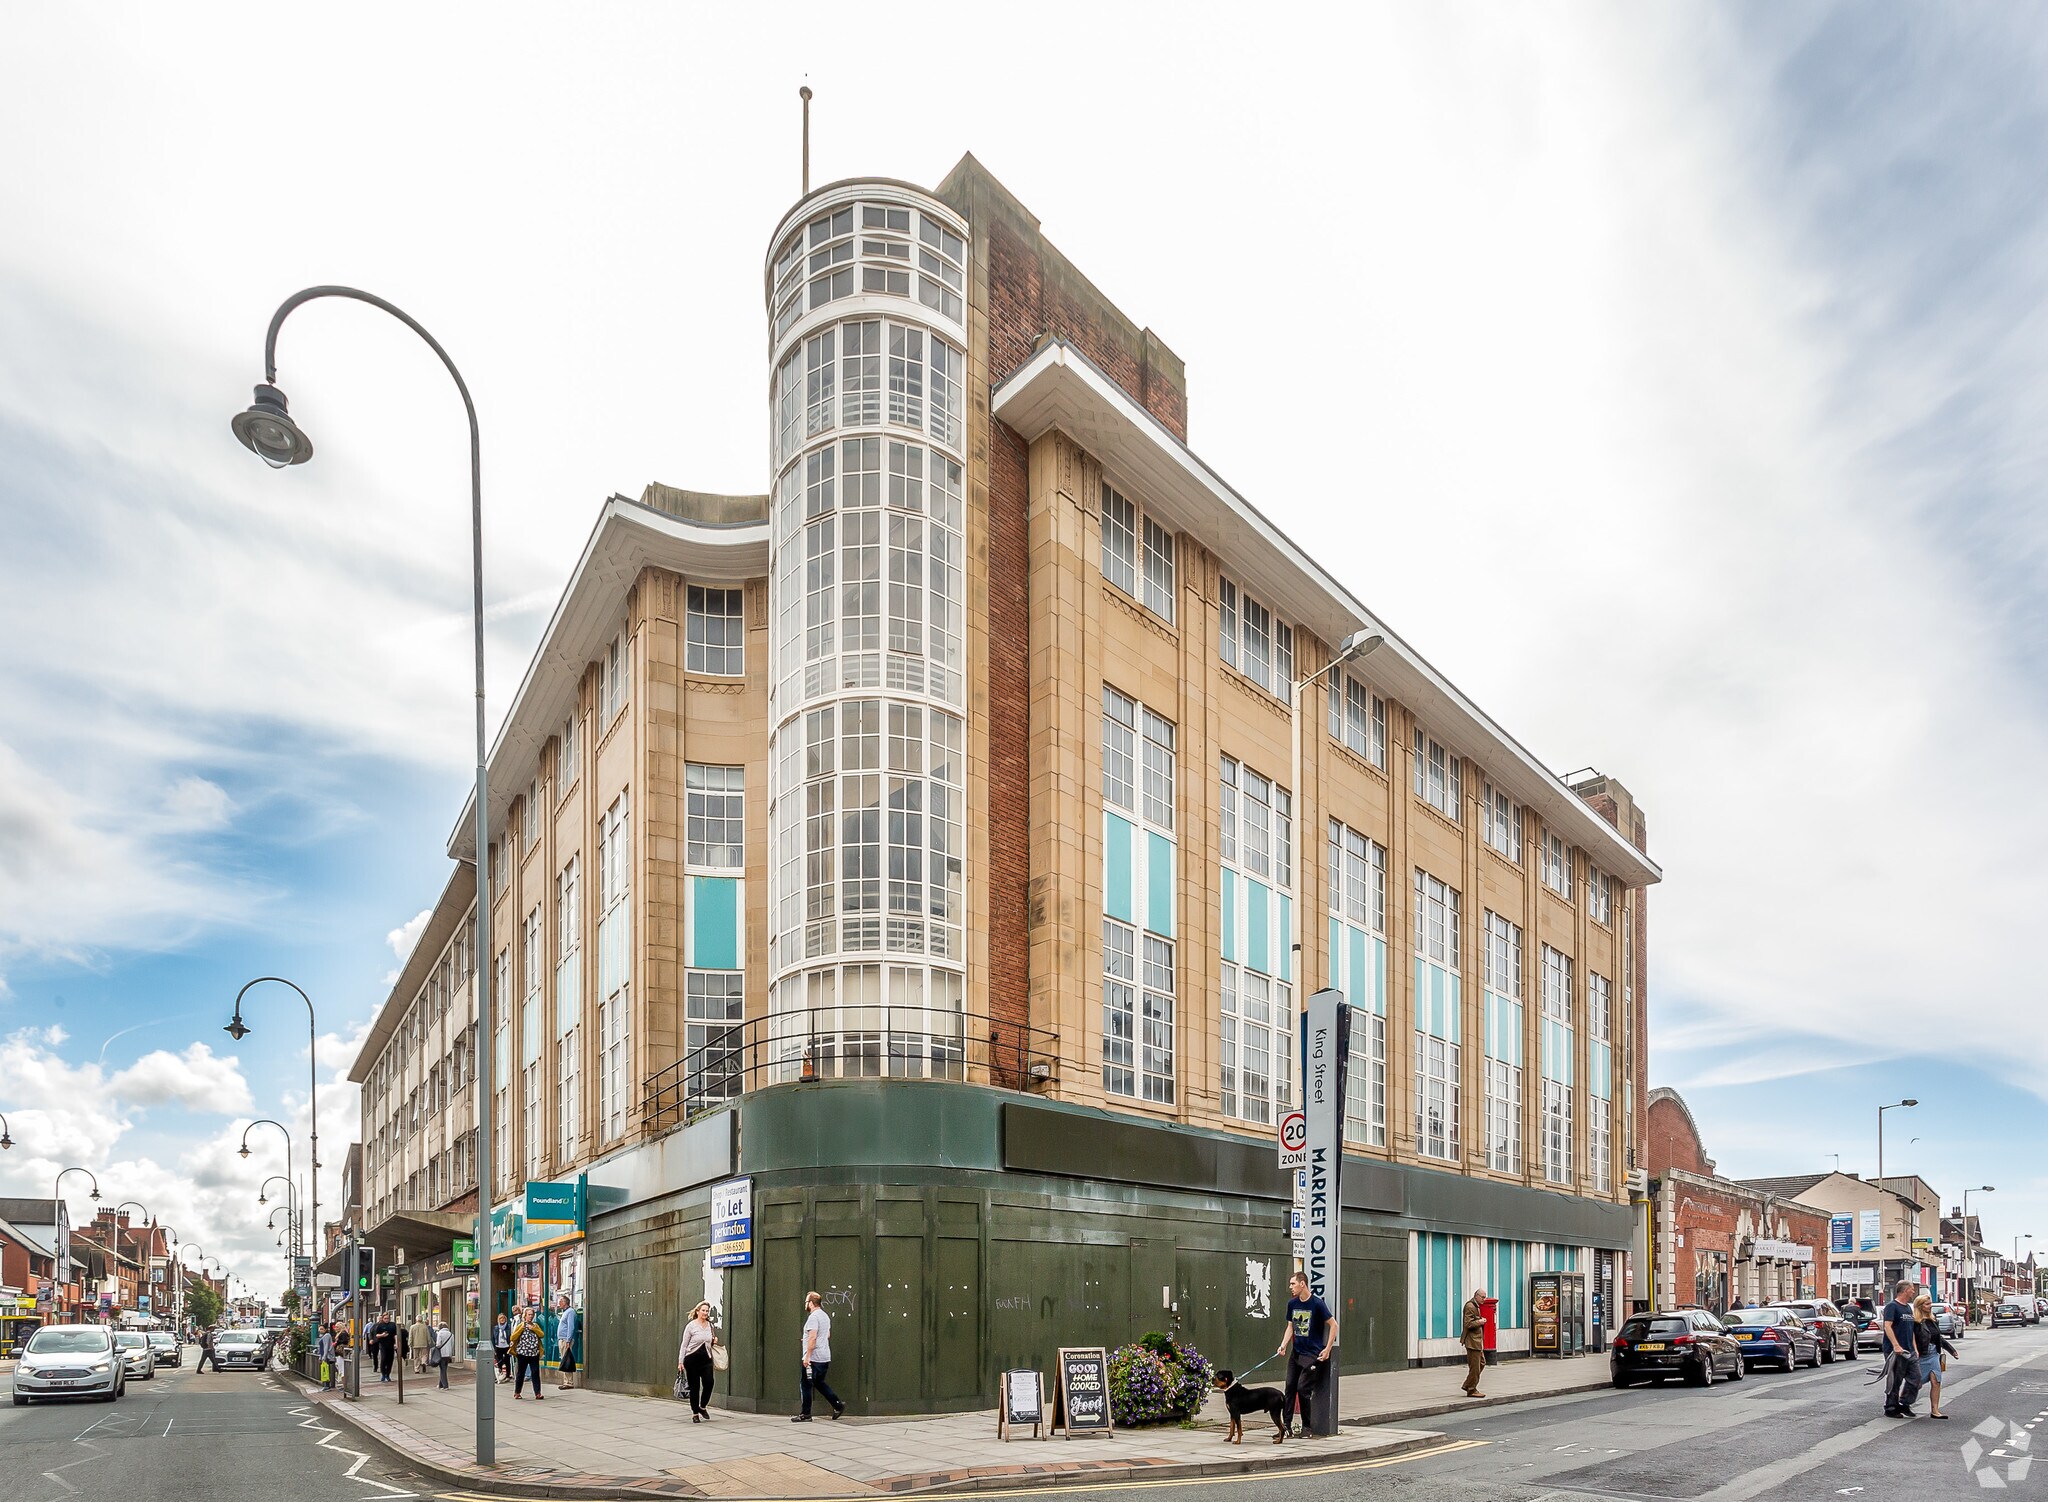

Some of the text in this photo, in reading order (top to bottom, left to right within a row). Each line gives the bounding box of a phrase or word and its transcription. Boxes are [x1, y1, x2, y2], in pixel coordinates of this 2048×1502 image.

[1312, 1028, 1327, 1104] King Street
[1286, 1124, 1306, 1140] 20
[1300, 1172, 1306, 1186] P
[726, 1185, 748, 1196] Restaurant
[716, 1199, 742, 1219] To Let
[714, 1221, 746, 1242] perkinsfox
[1311, 1148, 1327, 1302] MARKET QUAR
[732, 1241, 744, 1251] 6550
[1069, 1364, 1098, 1374] GOOD
[1073, 1374, 1098, 1382] HOME
[1070, 1382, 1101, 1390] COOKED
[1070, 1395, 1103, 1416] Food
